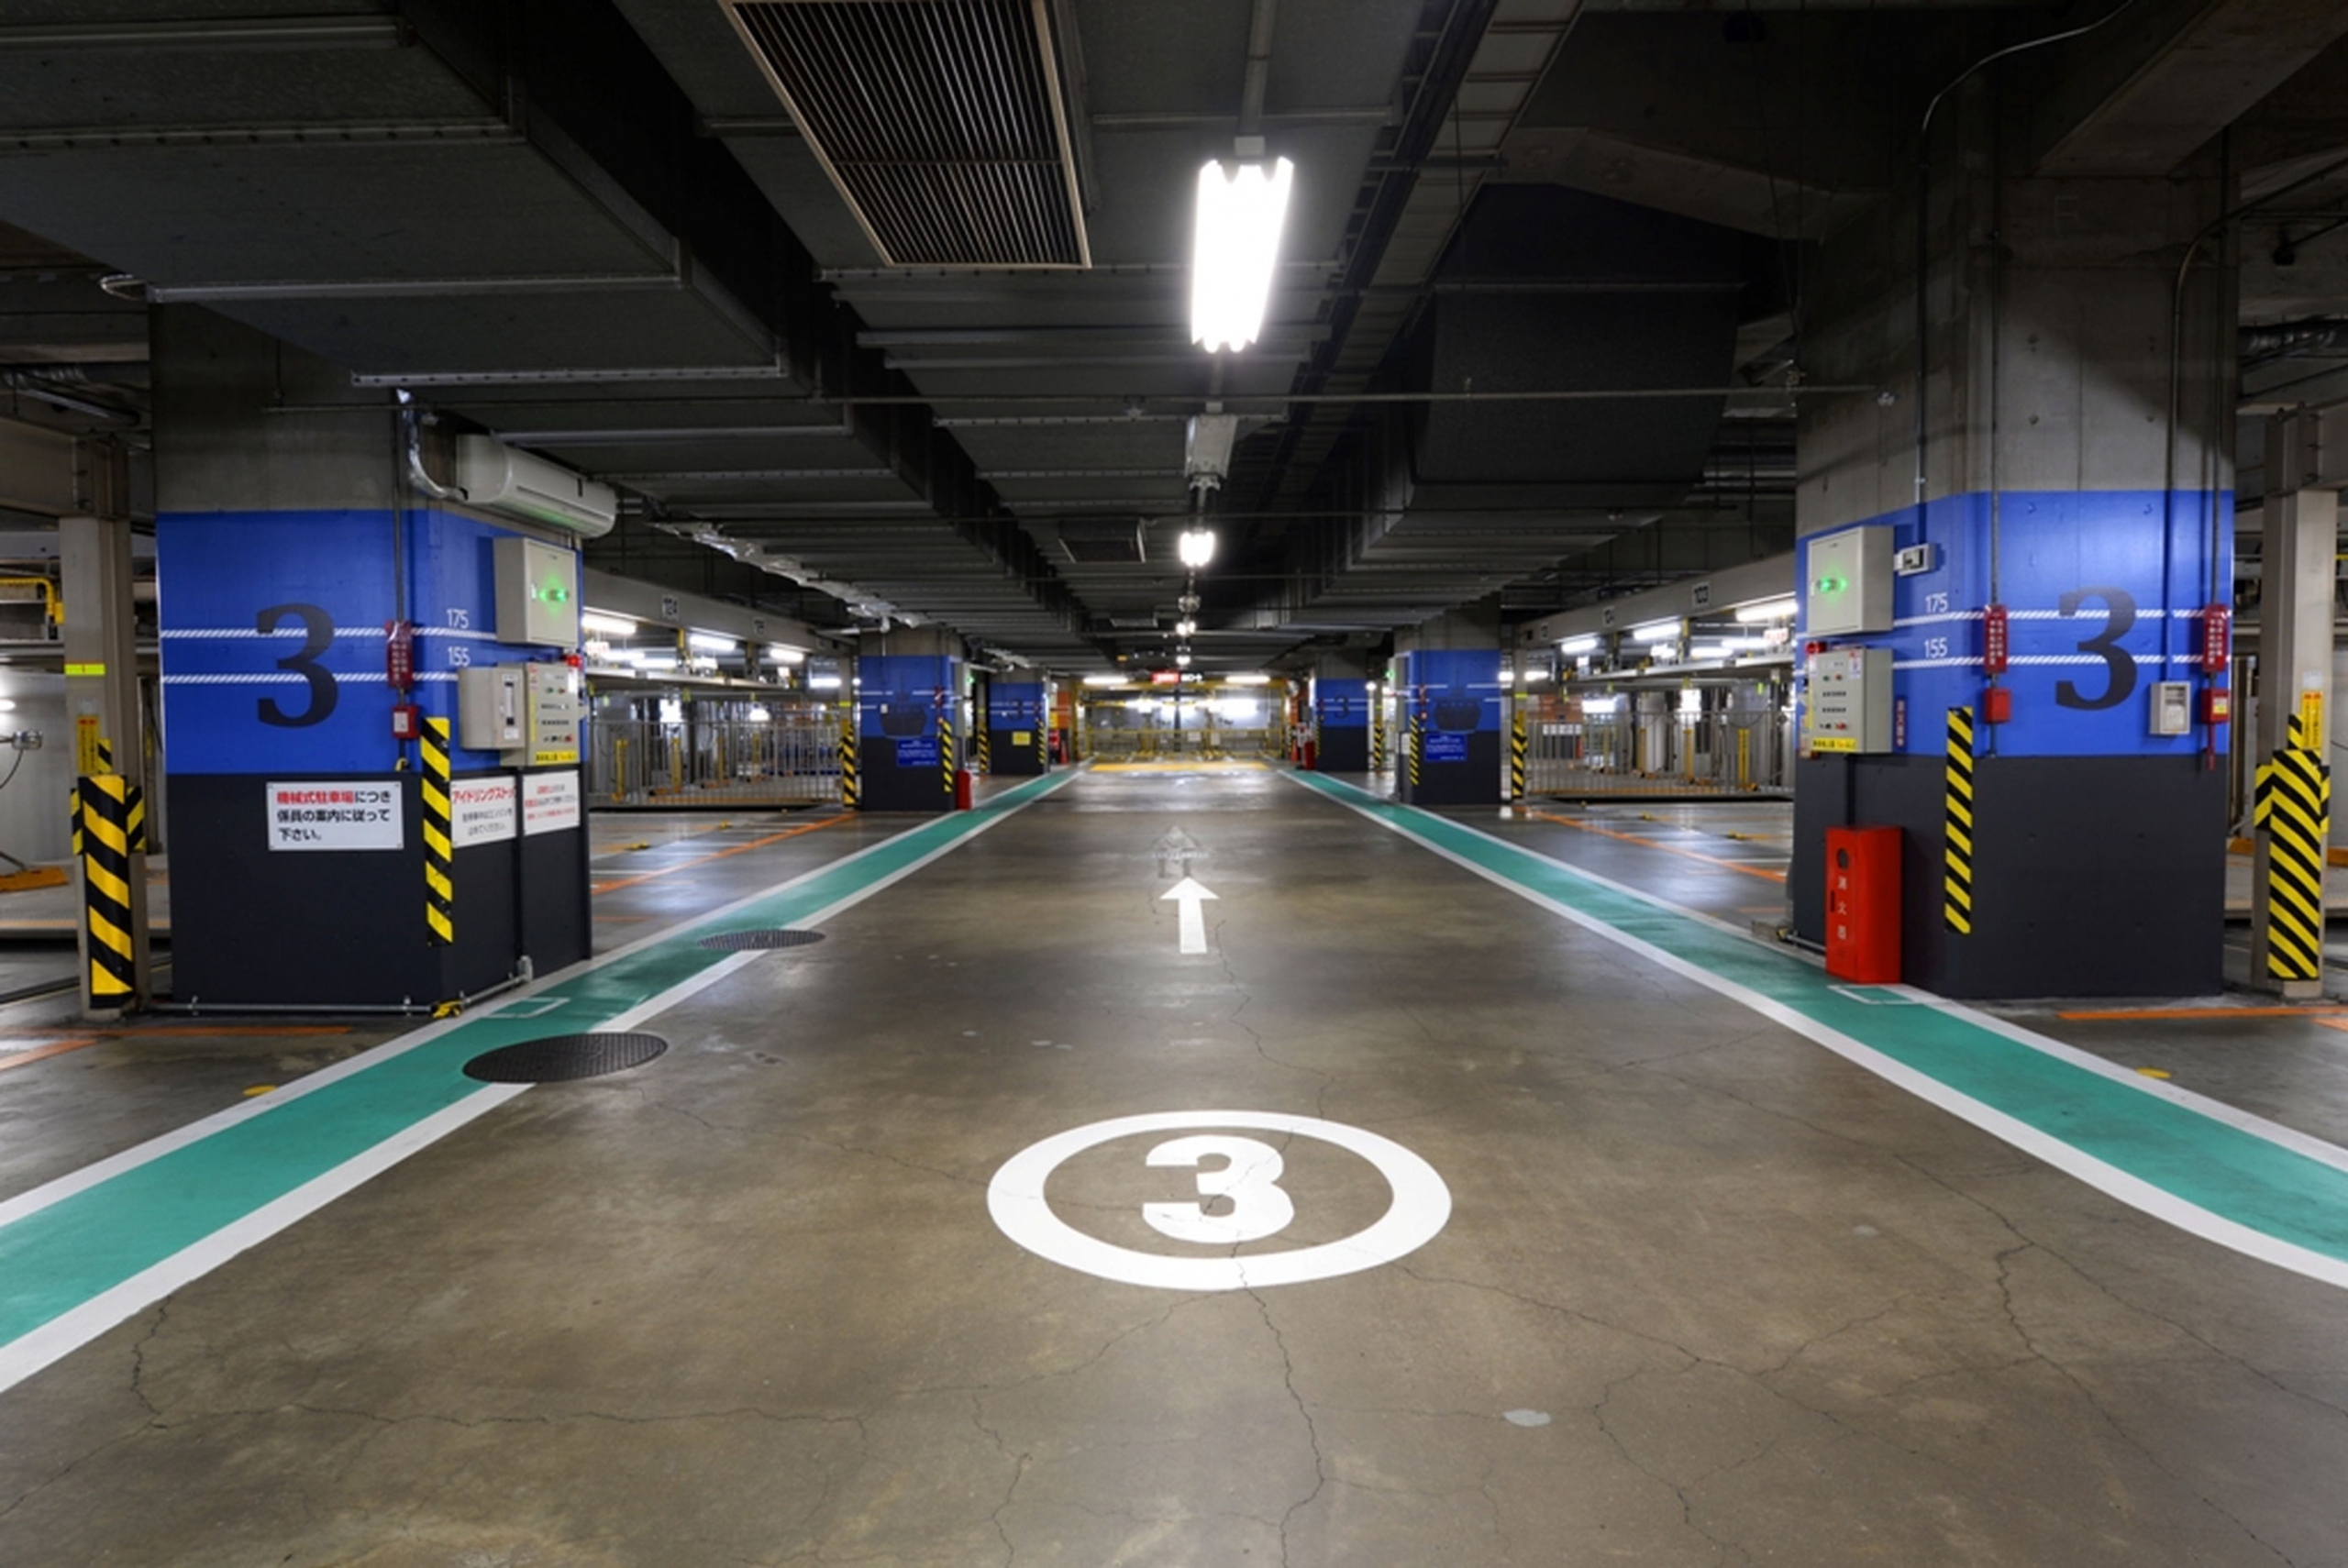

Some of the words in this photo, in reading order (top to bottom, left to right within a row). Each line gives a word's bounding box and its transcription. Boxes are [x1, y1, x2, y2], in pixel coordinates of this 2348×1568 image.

[1925, 592, 1949, 613] 175
[447, 608, 470, 629] 175
[448, 646, 471, 667] 155
[1924, 636, 1948, 658] 155
[2055, 586, 2137, 711] 3
[257, 602, 338, 728] 3
[277, 790, 391, 805] 機械式駐車場につき
[277, 808, 391, 823] 係員の案内に従って
[278, 827, 322, 842] 下さい。
[1142, 1134, 1295, 1243] 3
